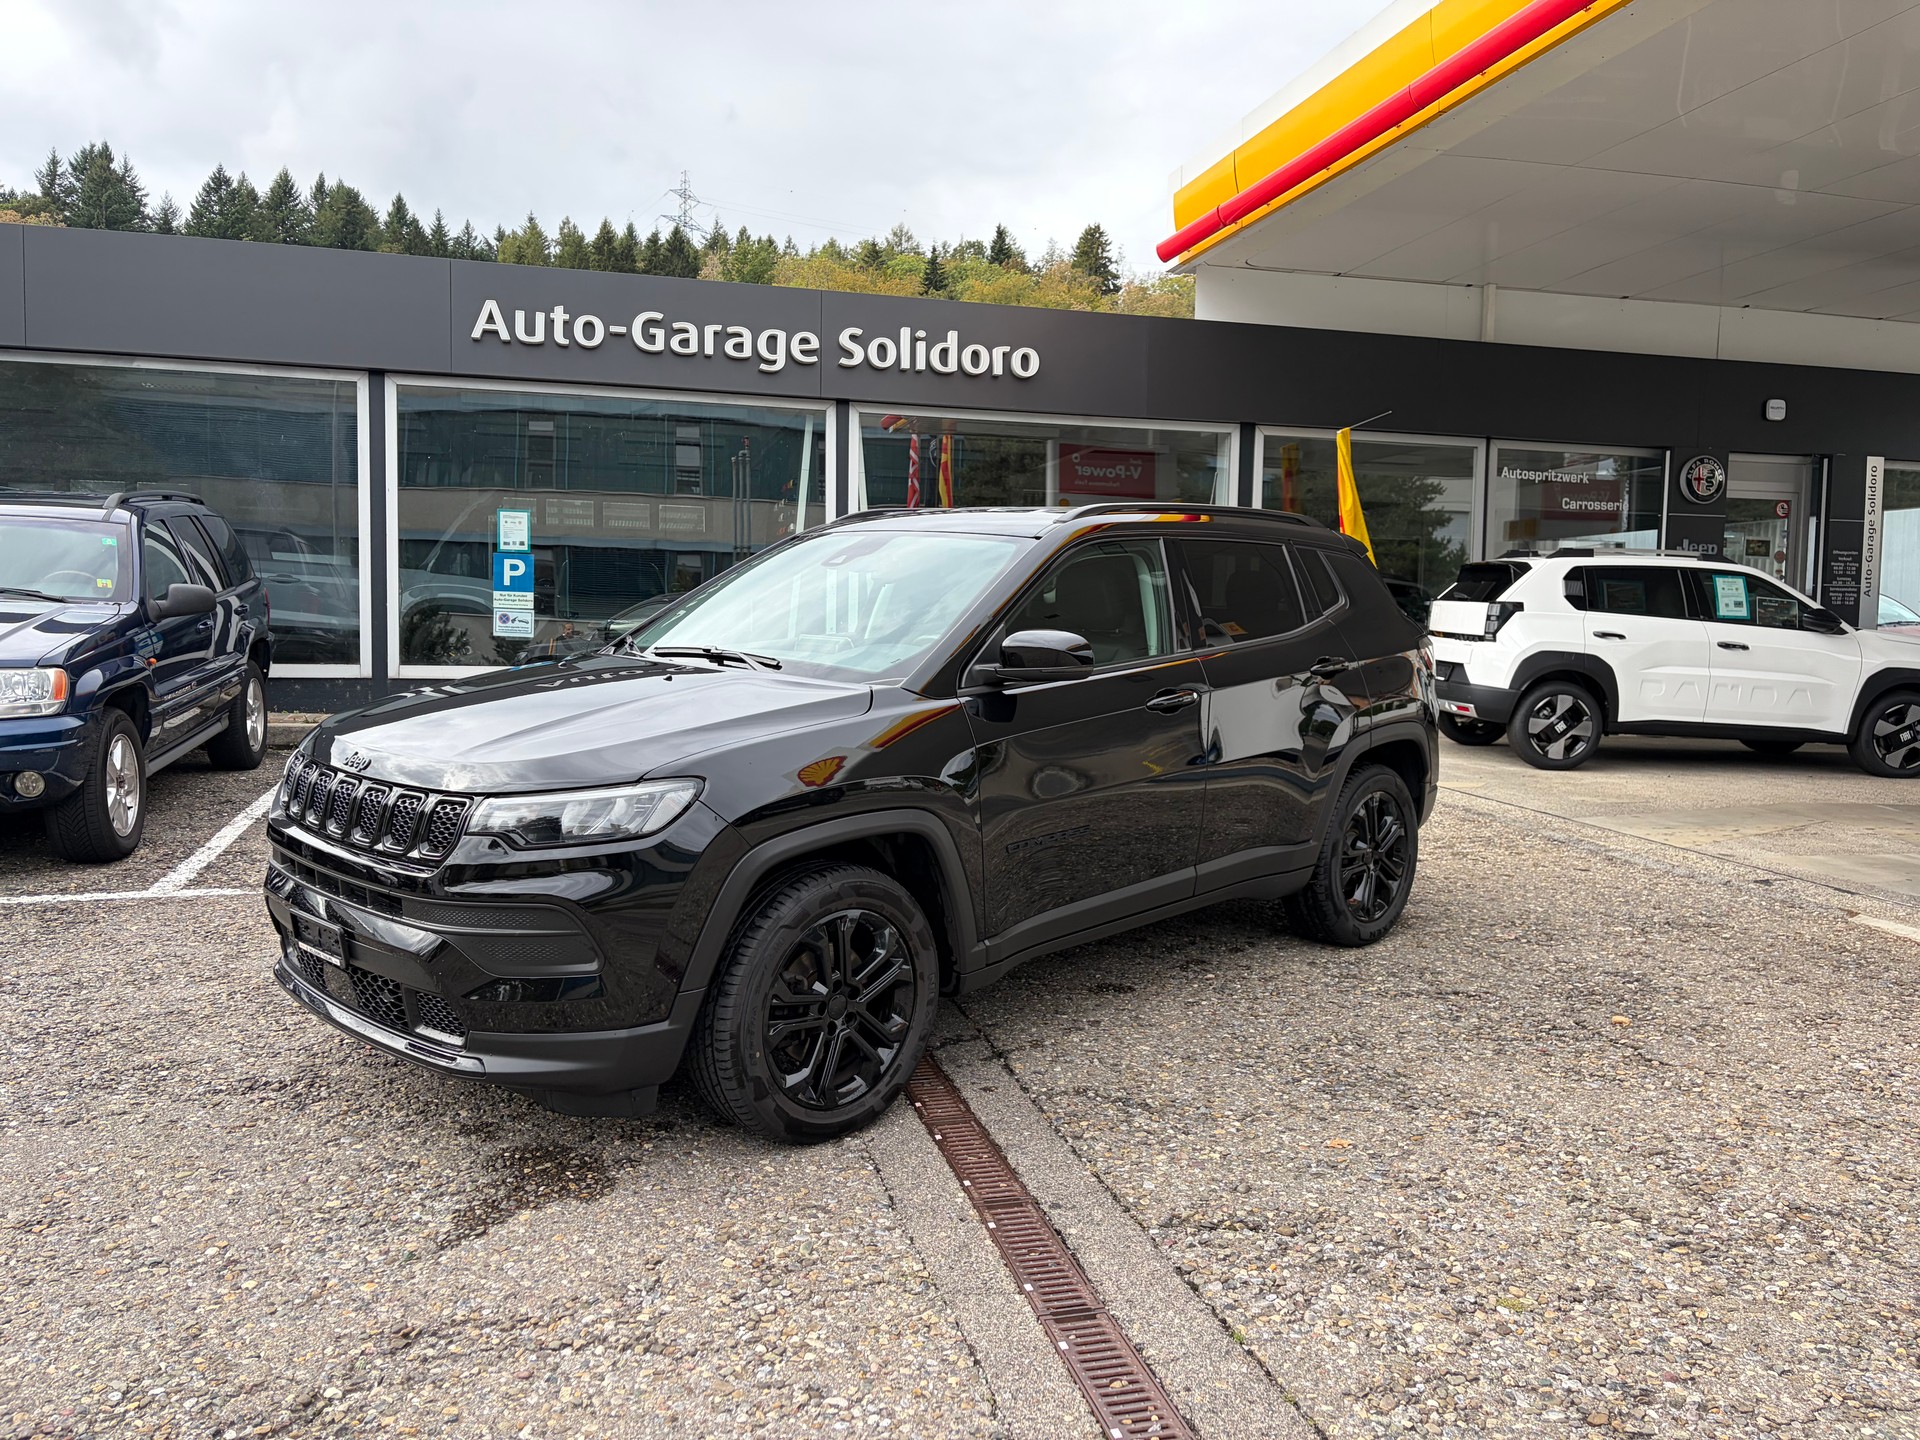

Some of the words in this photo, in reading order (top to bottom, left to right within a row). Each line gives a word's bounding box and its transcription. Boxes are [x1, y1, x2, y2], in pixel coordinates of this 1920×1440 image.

[470, 299, 819, 373] Auto-Garage
[837, 326, 1040, 379] Solidoro
[1501, 466, 1589, 484] Autospritzwerk
[1868, 465, 1878, 515] Solidoro
[1562, 497, 1629, 511] Carrosserie
[503, 558, 526, 586] P
[1863, 519, 1877, 597] Auto-Garage
